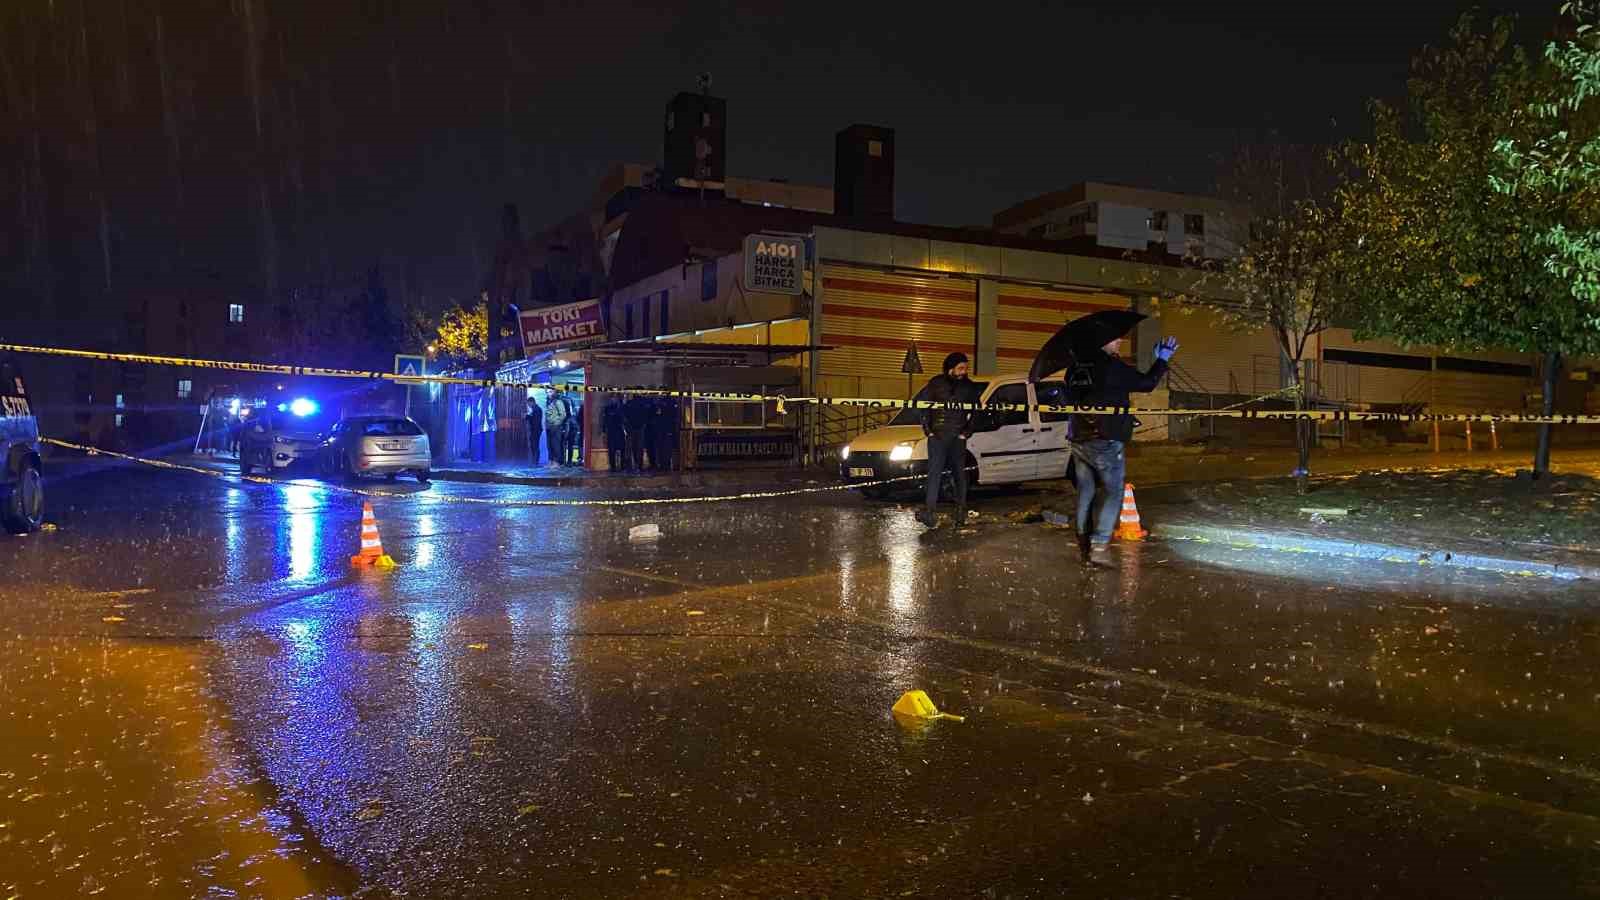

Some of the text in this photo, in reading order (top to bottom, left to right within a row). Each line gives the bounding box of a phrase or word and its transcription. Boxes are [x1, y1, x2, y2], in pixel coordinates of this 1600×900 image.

[755, 255, 794, 268] HARCA
[755, 265, 795, 278] HARCA
[526, 319, 599, 344] MARKET
